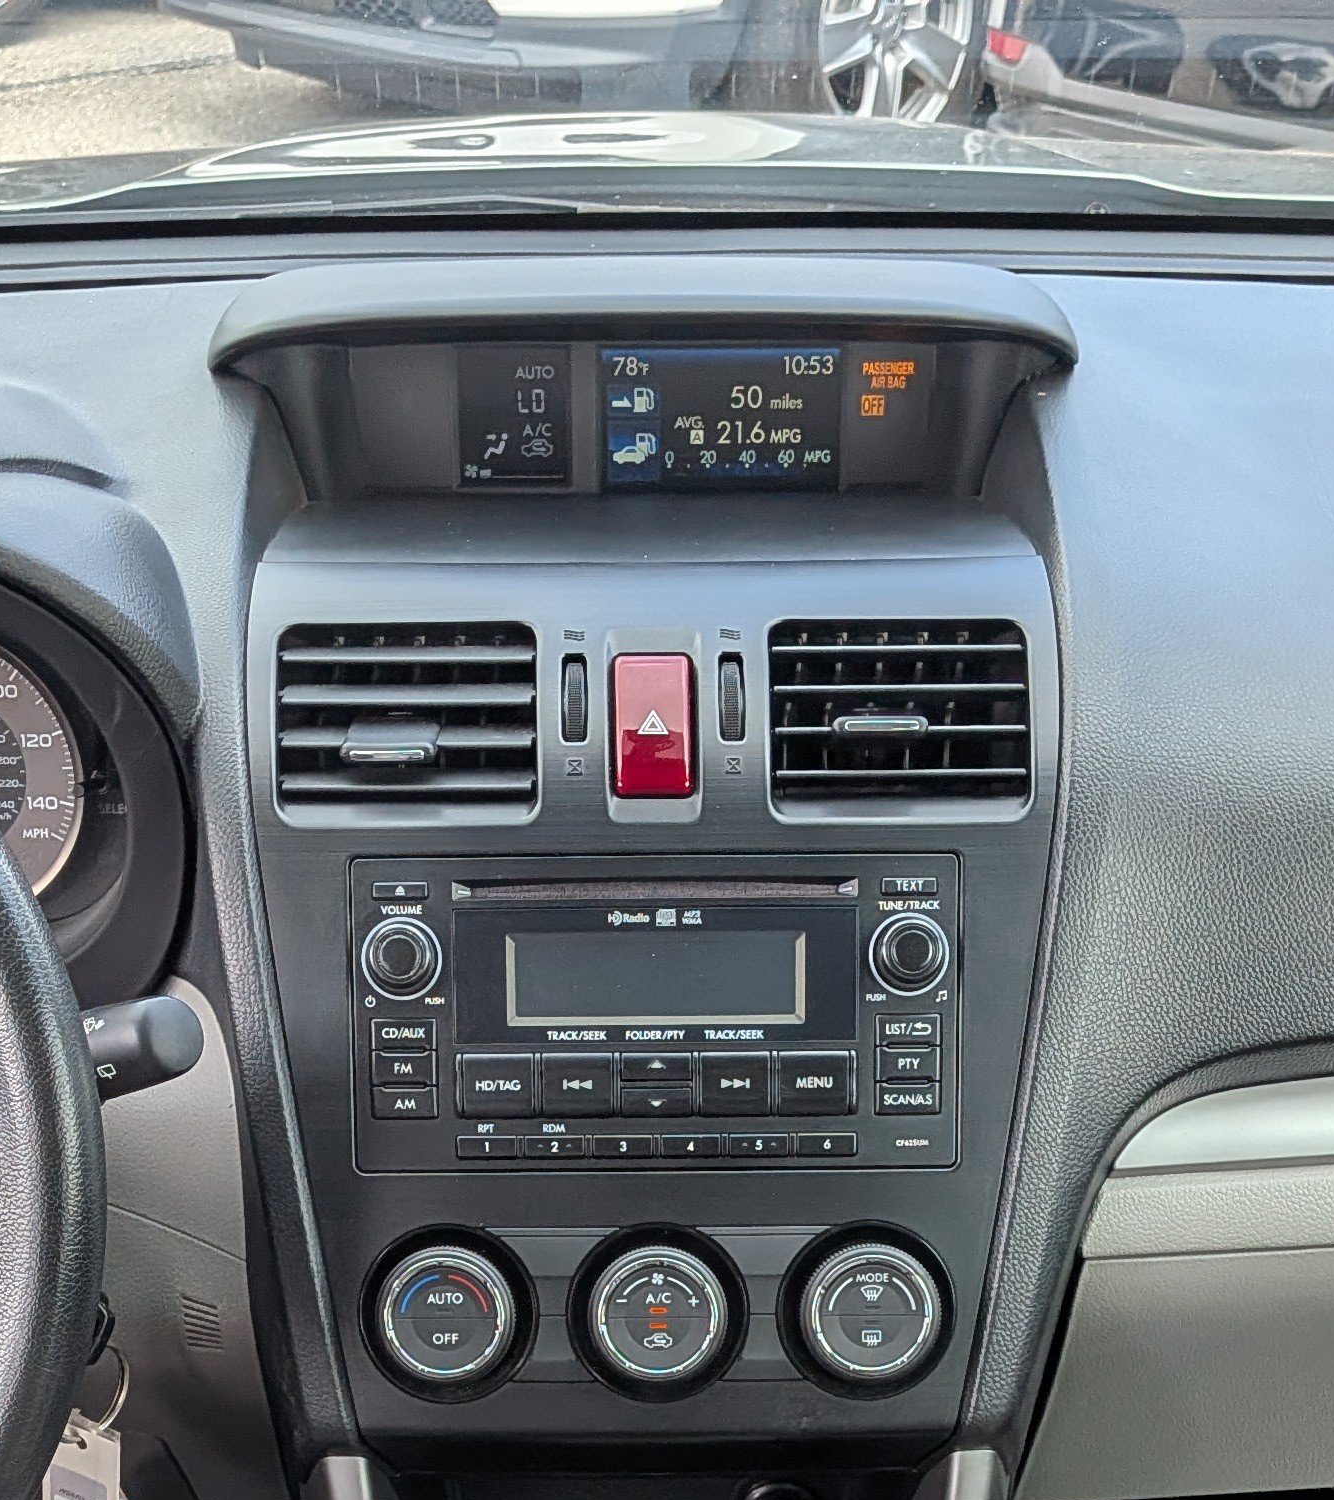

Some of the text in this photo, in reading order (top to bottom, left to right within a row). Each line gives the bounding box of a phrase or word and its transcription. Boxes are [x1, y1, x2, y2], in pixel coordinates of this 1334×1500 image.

[782, 355, 835, 376] 10:53
[862, 361, 915, 376] PASSENGER
[515, 365, 555, 380] AUTO
[870, 376, 907, 389] AIR BAG
[729, 385, 804, 410] 50 miles
[861, 396, 885, 415] OFF
[674, 416, 705, 430] AVG.
[522, 422, 553, 437] A/C
[717, 420, 766, 445] 21.6
[769, 428, 802, 444] MPG
[665, 450, 831, 465] 0 20 40 60 MPG
[20, 733, 52, 748] 120
[26, 796, 58, 810] 140
[22, 828, 49, 839] MPH
[895, 880, 925, 891] TEXT
[380, 904, 423, 915] VOLUME
[877, 899, 940, 910] TUNE/TRACK
[622, 912, 650, 923] Radio
[424, 997, 445, 1005] PUSH
[865, 993, 887, 1002] PUSH
[381, 1027, 426, 1040] CD/AUX
[546, 1030, 607, 1041] TRACK/SEEK
[624, 1030, 685, 1041] FOLDER/PTY
[703, 1029, 765, 1040] TRACK/SEEK
[393, 1063, 413, 1075] FM
[897, 1058, 921, 1070] PTY
[475, 1080, 522, 1092] HD/TAG
[795, 1077, 834, 1088] MENU
[394, 1098, 417, 1110] AM
[477, 1123, 495, 1134] RPT
[542, 1123, 566, 1134] RDM
[484, 1142, 490, 1152] 1
[551, 1141, 559, 1152] 2
[619, 1141, 627, 1152] 3
[686, 1141, 695, 1152] 4
[755, 1140, 763, 1151] 5
[823, 1139, 831, 1150] 6
[855, 1272, 890, 1284] MODE
[426, 1292, 464, 1306] AUTO
[644, 1291, 672, 1305] A/C
[432, 1332, 460, 1345] OFF
